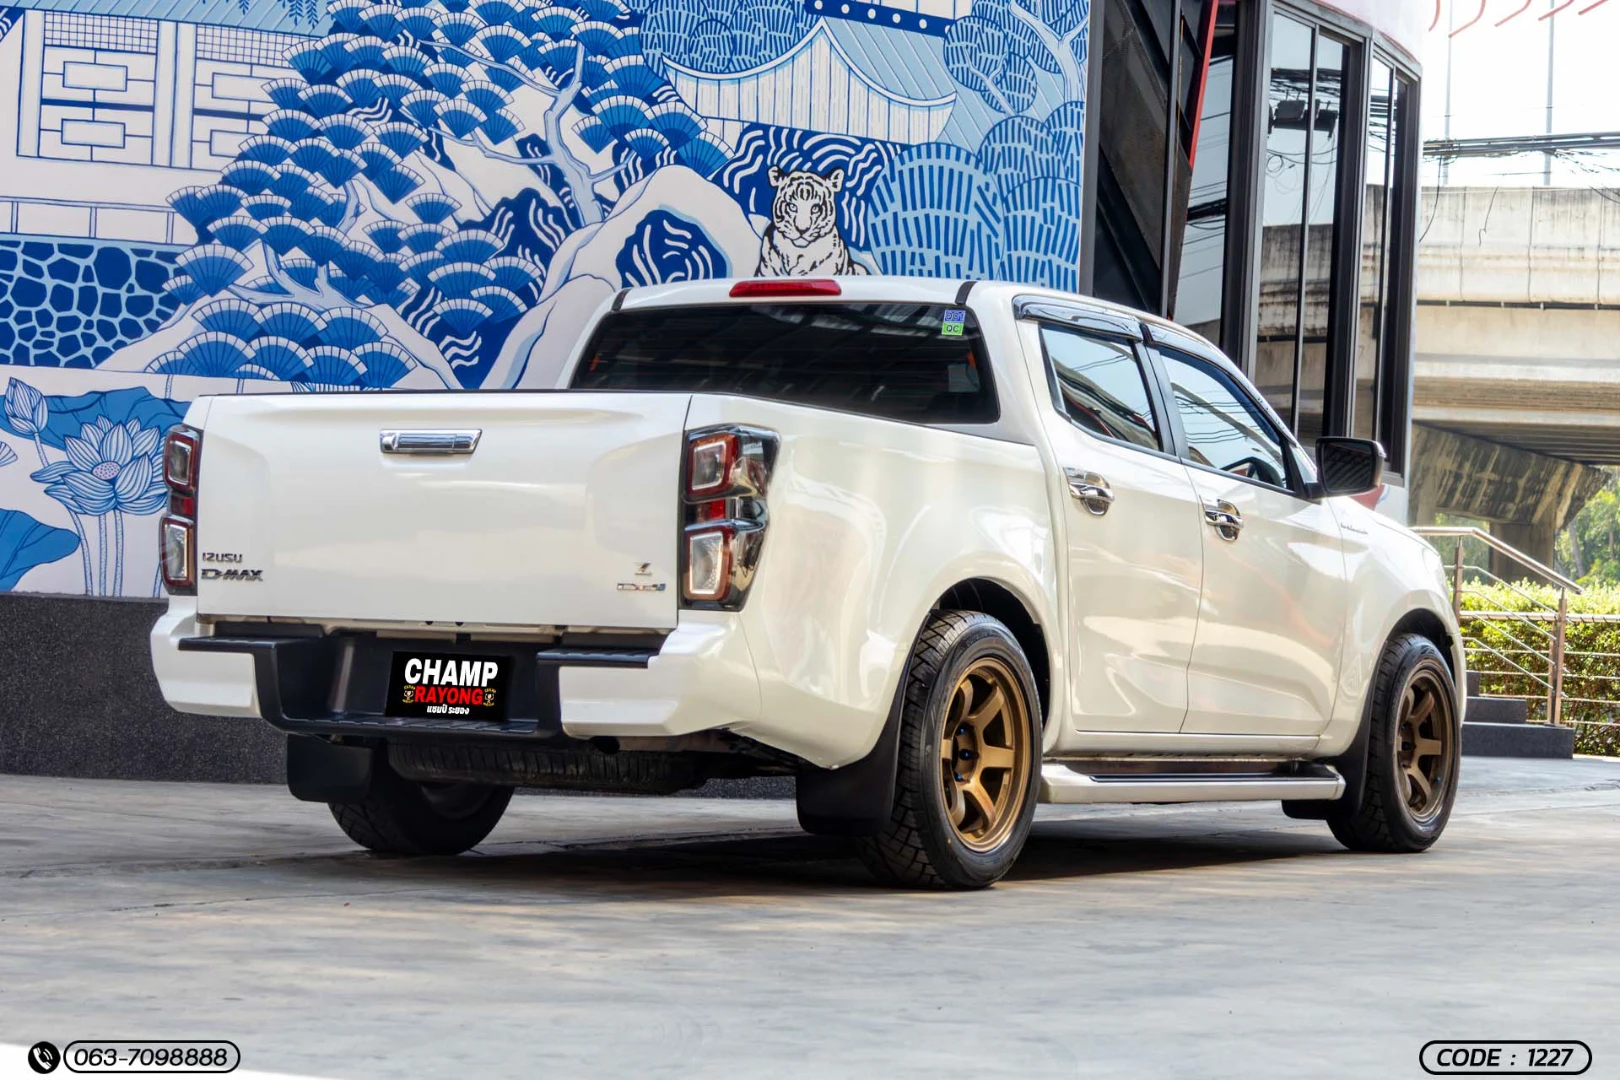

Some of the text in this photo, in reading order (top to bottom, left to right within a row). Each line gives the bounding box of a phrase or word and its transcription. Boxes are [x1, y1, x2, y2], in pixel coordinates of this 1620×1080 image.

[201, 568, 263, 581] D-MAX
[404, 658, 499, 687] CHAMP
[414, 685, 484, 706] RAYONG
[448, 706, 470, 715] ระยอง
